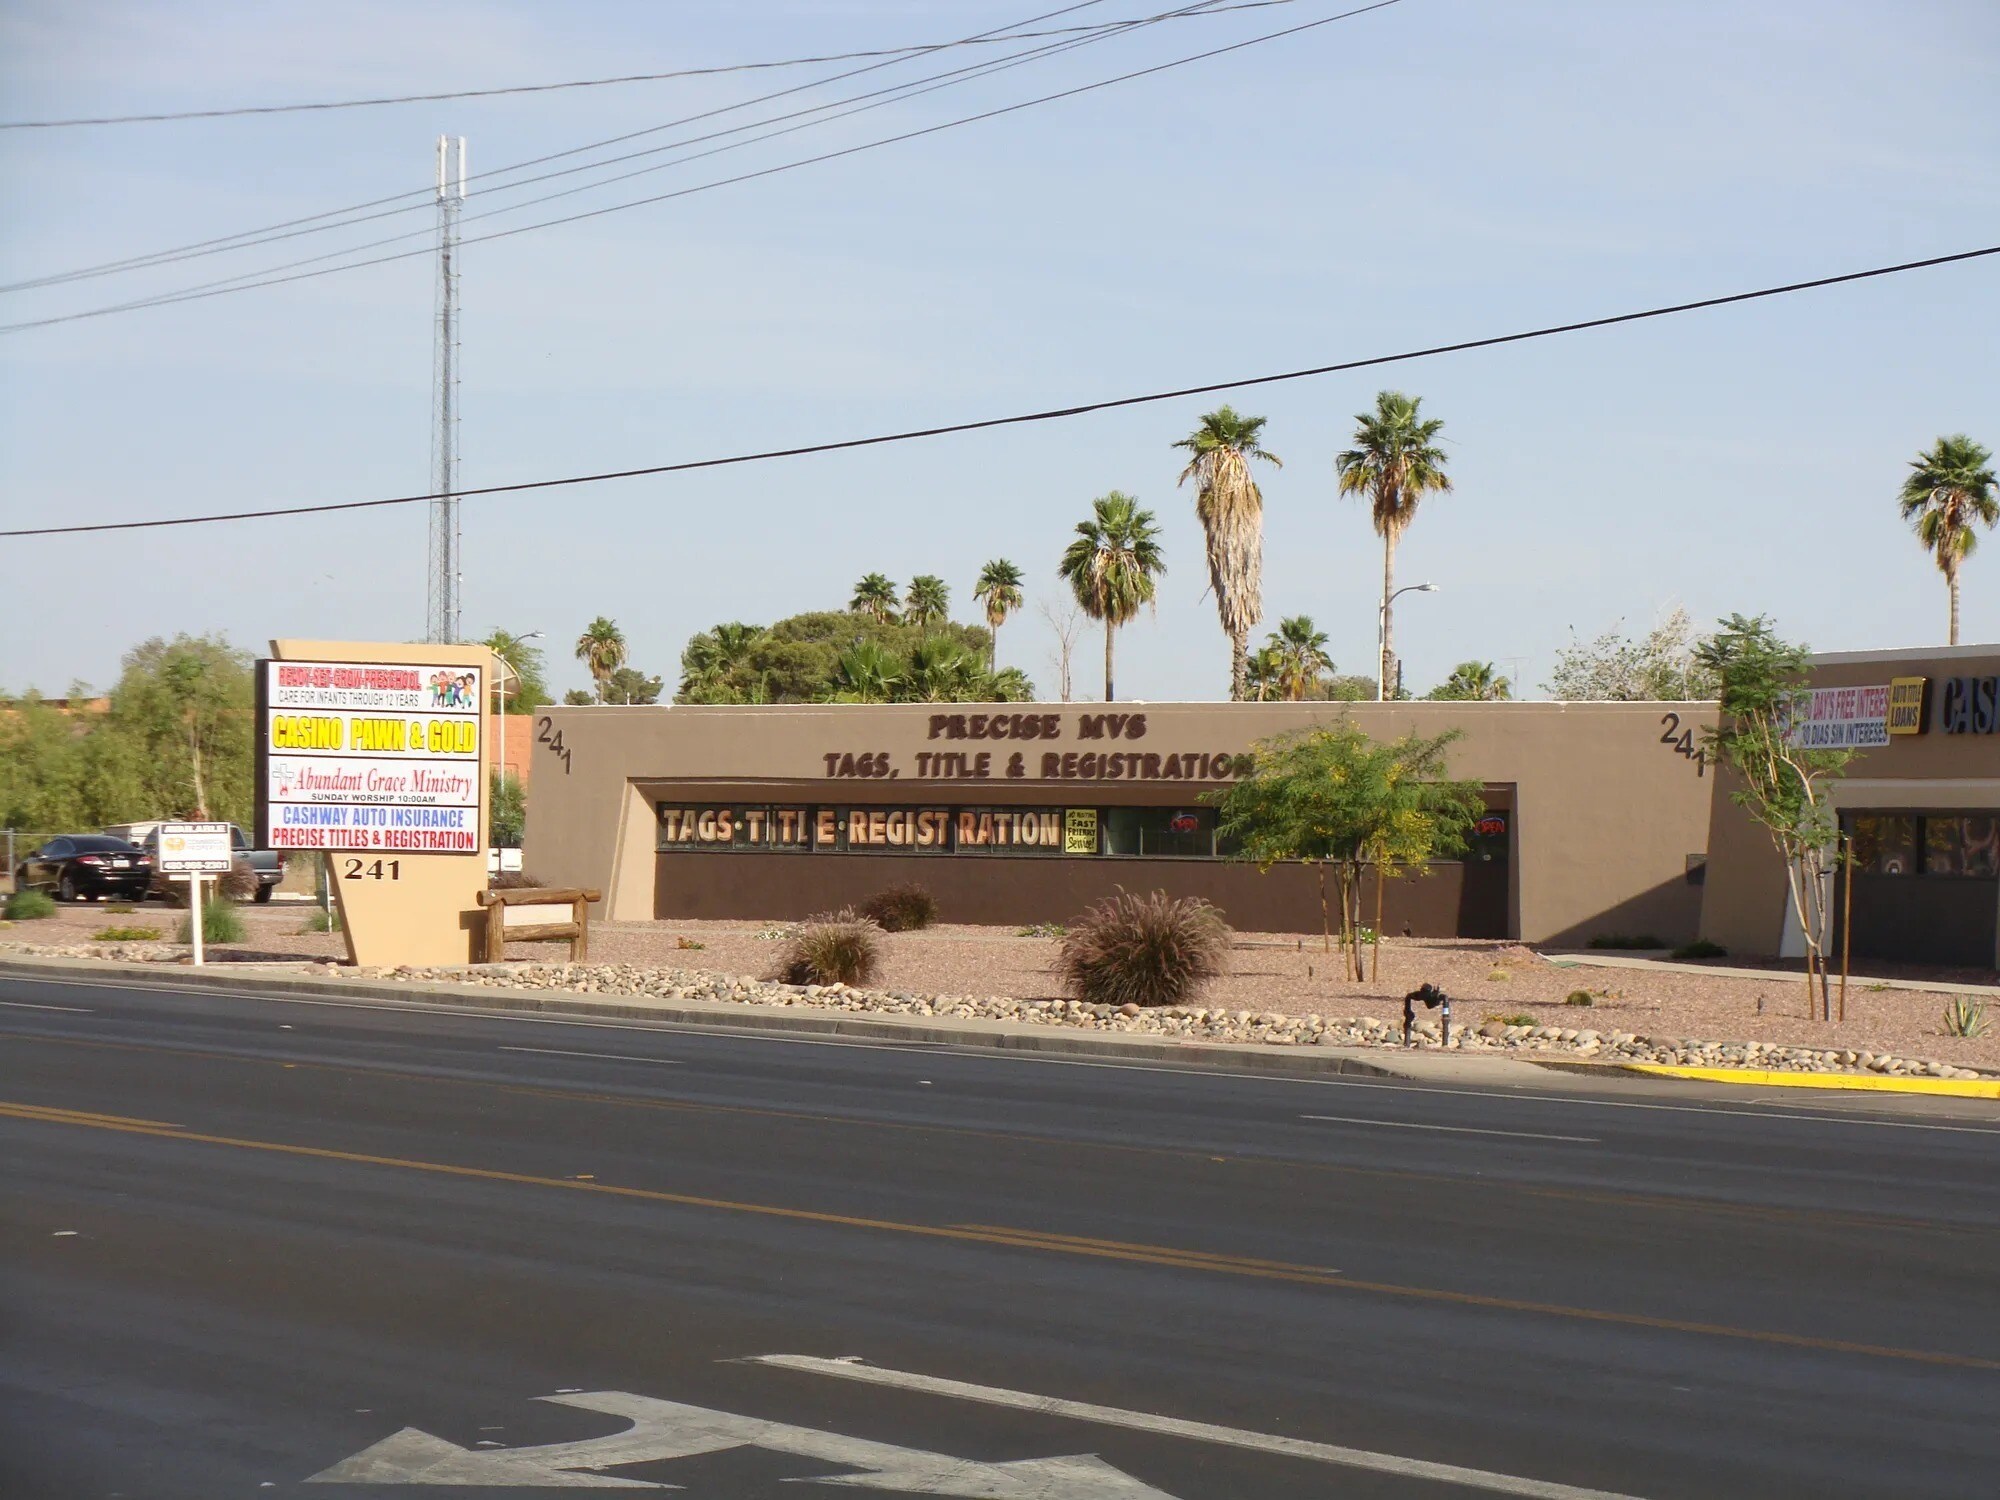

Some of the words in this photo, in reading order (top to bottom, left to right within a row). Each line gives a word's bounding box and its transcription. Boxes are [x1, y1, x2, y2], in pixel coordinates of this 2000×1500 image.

[279, 690, 299, 703] CARE
[301, 690, 316, 704] FOR
[318, 691, 347, 705] INFANTS
[349, 692, 383, 706] THROUGH
[385, 693, 393, 706] 12
[395, 693, 419, 707] YEARS
[1836, 690, 1856, 719] FREE
[927, 714, 1061, 740] PRECISE
[1077, 713, 1147, 740] MVS
[1890, 706, 1918, 727] LOANS
[273, 715, 343, 750] CASINO
[350, 718, 406, 751] PAWN
[409, 721, 425, 750] &
[428, 720, 476, 753] GOLD
[538, 716, 571, 774] 241
[1660, 712, 1705, 777] 241
[823, 752, 900, 779] TAGS,
[915, 752, 991, 778] TITLE
[1005, 752, 1026, 778] &
[293, 766, 363, 791] Abundant
[367, 768, 406, 792] Grace
[410, 768, 473, 801] Ministry
[311, 793, 349, 801] SUNDAY
[351, 794, 395, 802] WORSHIP
[398, 795, 436, 803] 10:00AM
[283, 806, 348, 826] CASHWAY
[352, 808, 386, 826] AUTO
[391, 808, 464, 828] INSURANCE
[1072, 819, 1095, 828] FAST
[273, 828, 325, 847] PRECISE
[329, 829, 368, 847] TITLES
[372, 830, 381, 845] &
[385, 830, 474, 849] REGISTRATION
[344, 858, 400, 880] 241
